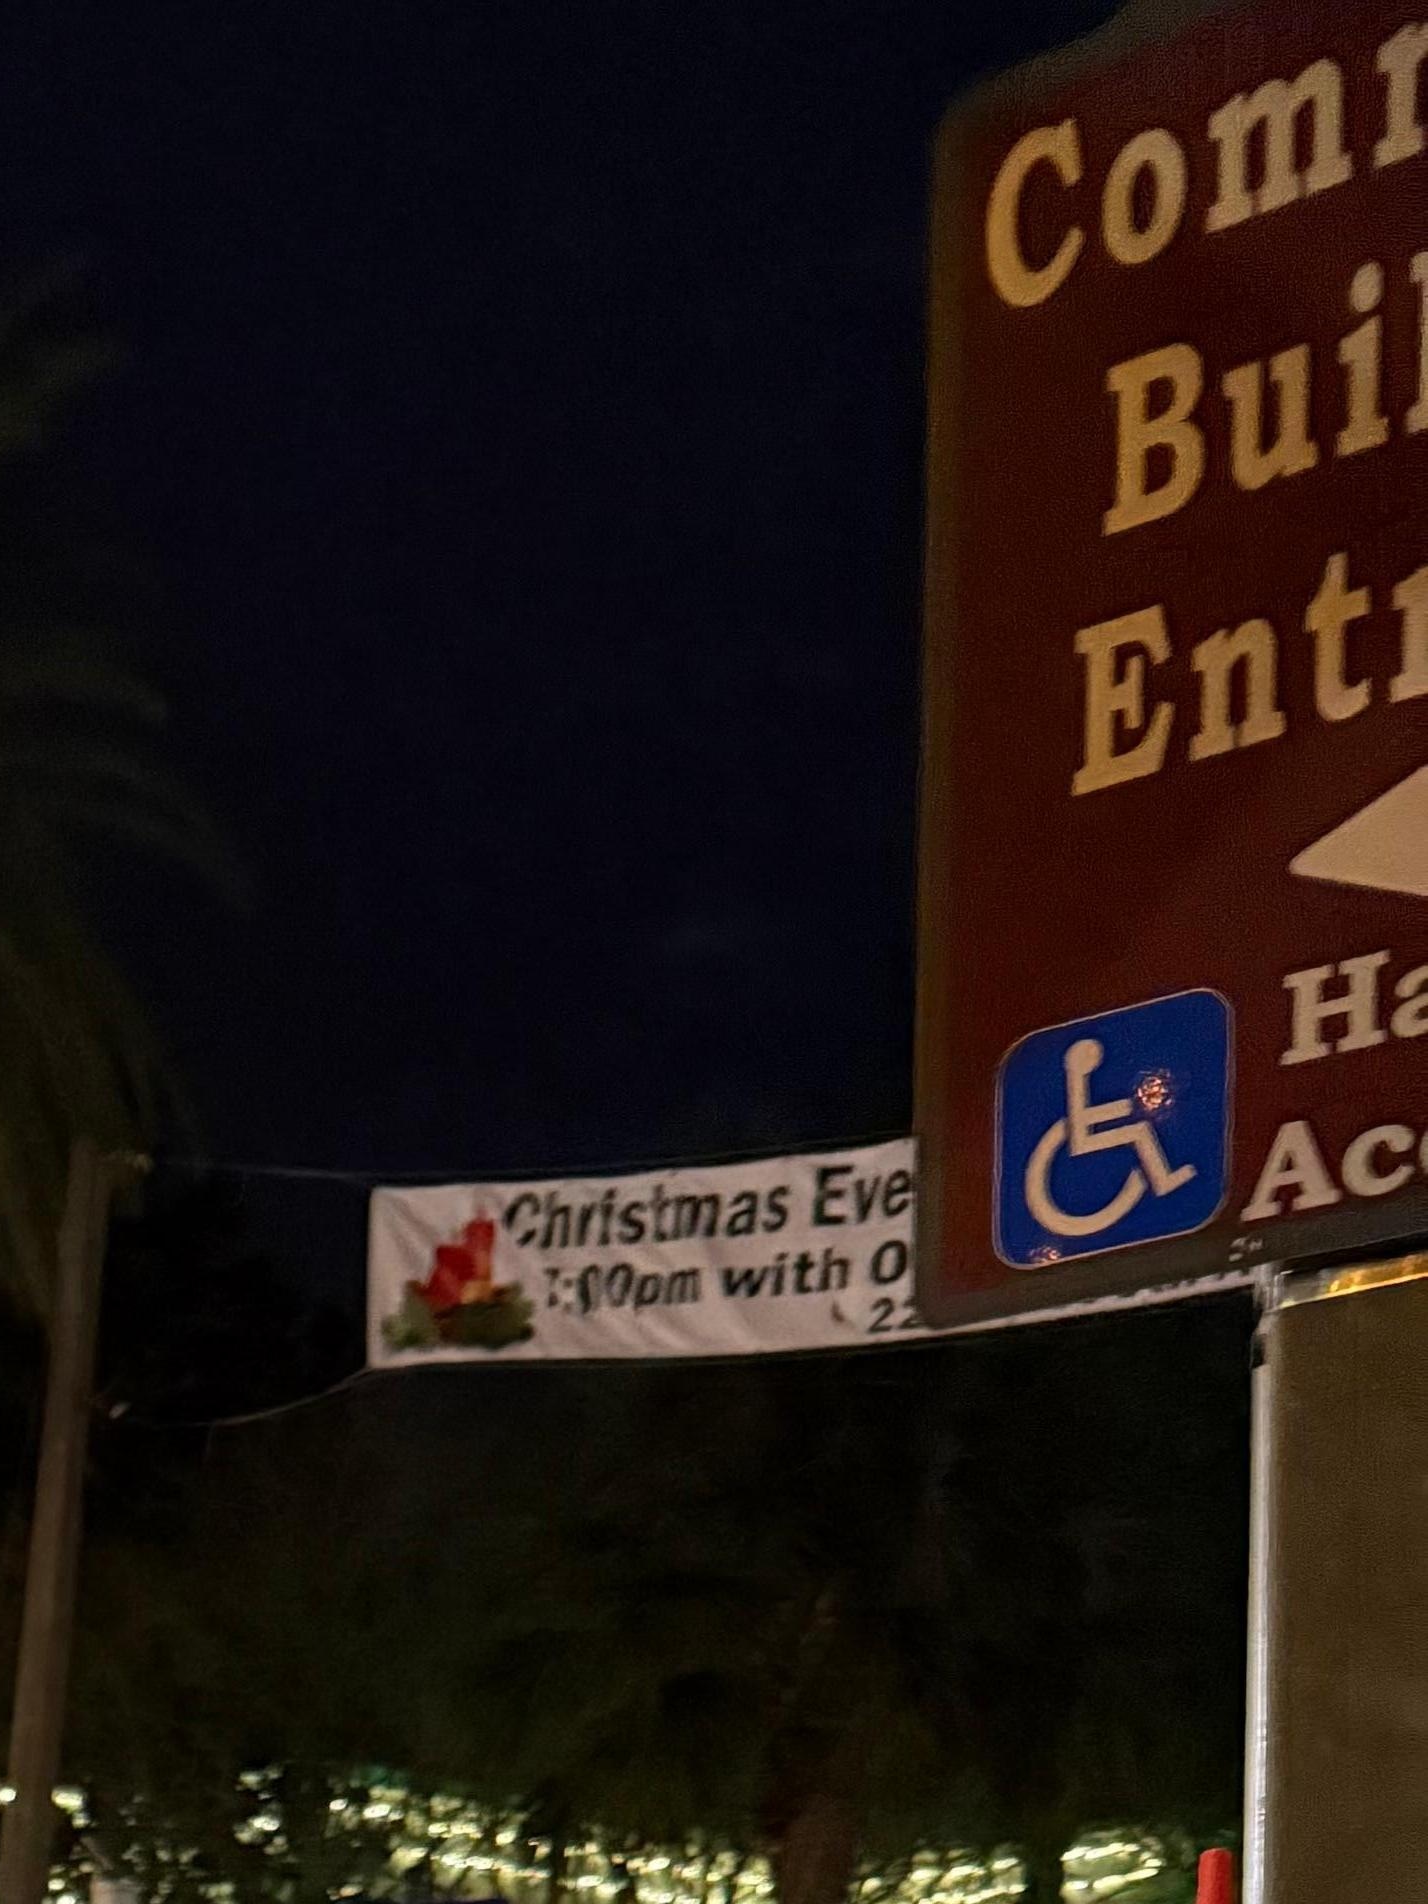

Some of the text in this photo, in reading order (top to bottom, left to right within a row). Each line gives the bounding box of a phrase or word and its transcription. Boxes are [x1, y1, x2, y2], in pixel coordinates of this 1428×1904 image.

[501, 1164, 911, 1250] Christmas Eve
[1241, 1119, 1428, 1222] Ac
[722, 1247, 850, 1299] with
